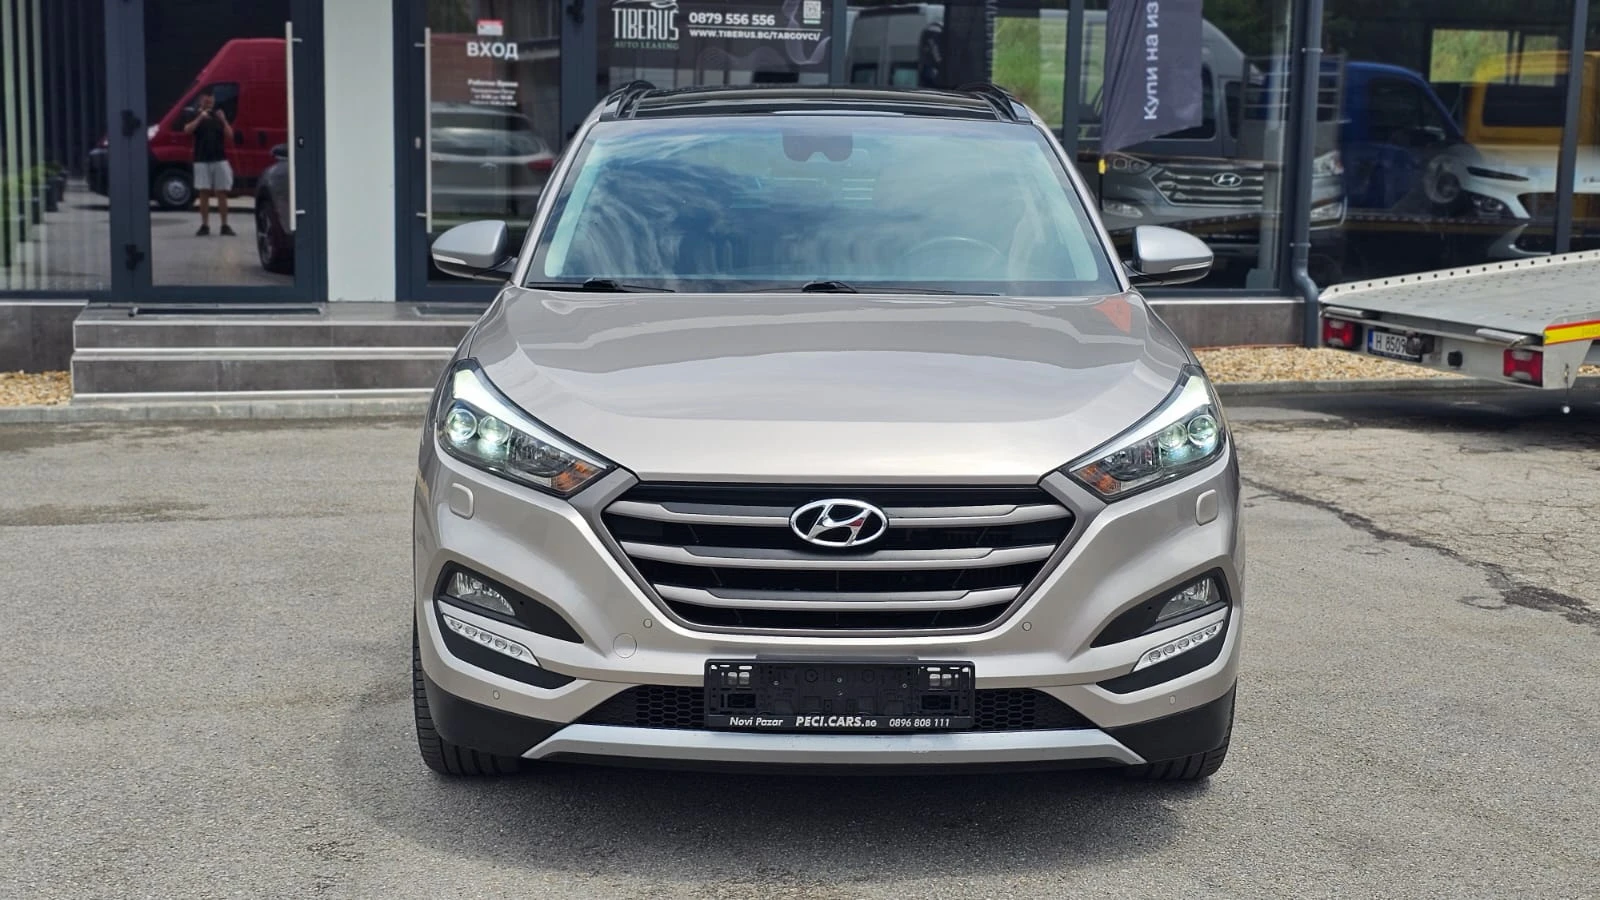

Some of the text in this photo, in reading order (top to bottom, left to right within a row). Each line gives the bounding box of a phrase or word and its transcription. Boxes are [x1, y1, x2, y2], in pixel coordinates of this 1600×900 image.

[611, 7, 680, 41] TIBERUS
[689, 12, 775, 26] 0879 556 556
[466, 41, 519, 60] ВХОД
[614, 41, 680, 50] AUTO LEASING
[1145, 34, 1159, 61] на
[1144, 67, 1160, 120] Купи
[729, 716, 754, 726] Novi
[755, 717, 784, 726] Pazar
[889, 718, 912, 727] 0896
[913, 718, 931, 727] 808
[933, 718, 950, 727] 111
